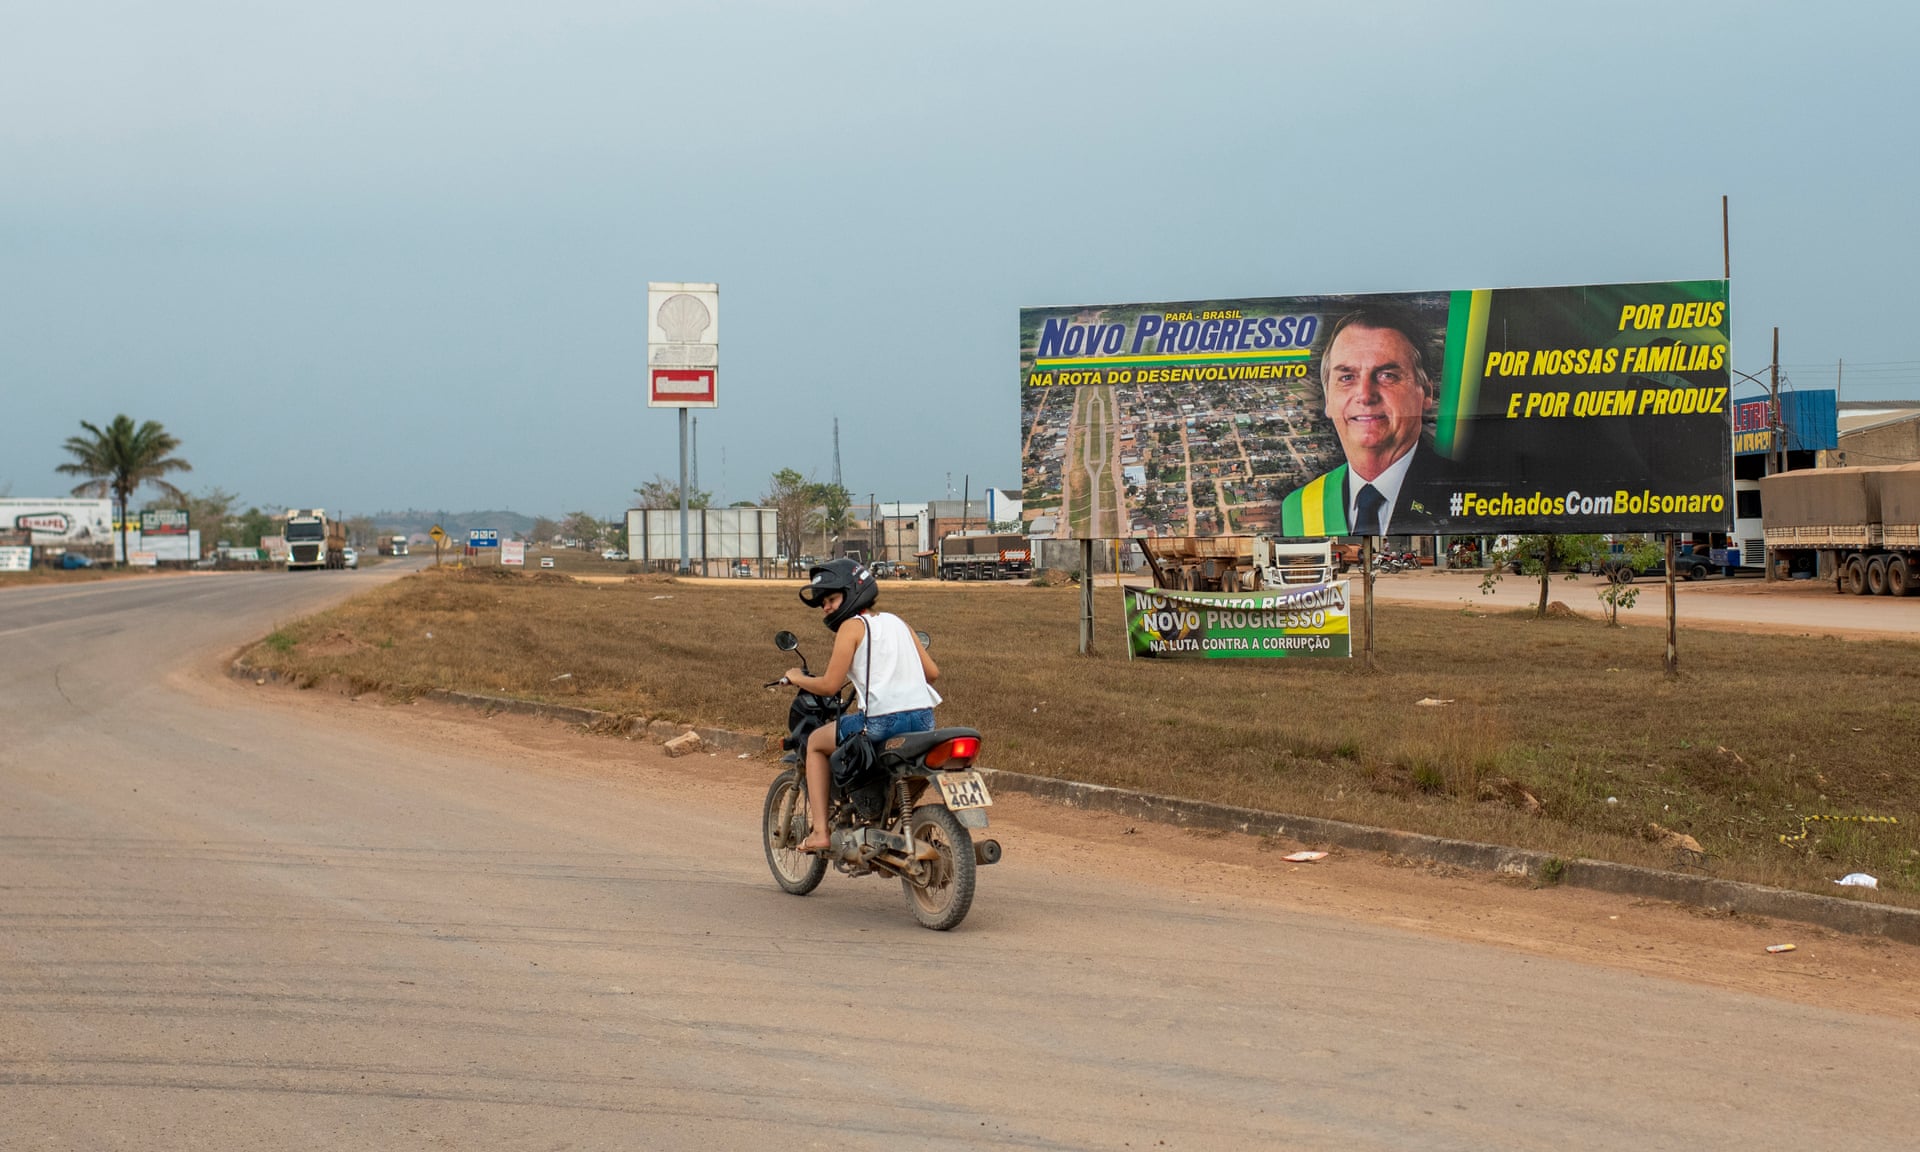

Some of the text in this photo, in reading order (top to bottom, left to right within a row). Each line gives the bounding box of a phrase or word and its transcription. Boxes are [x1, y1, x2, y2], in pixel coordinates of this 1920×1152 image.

[1164, 311, 1192, 321] PARÁ
[1203, 310, 1242, 321] BRASIL
[1618, 301, 1726, 331] POR DEUS
[1037, 314, 1318, 357] NOVO PROGRESSO
[1485, 340, 1726, 377] POR NOSSAS FAMÍLIAS
[1029, 364, 1307, 387] NA ROTA DO DESENVOLVIMENTO
[1507, 387, 1728, 419] E POR QUEM PRODUZ
[1450, 490, 1724, 517] #FechadosComBolsonaro
[1262, 586, 1344, 610] RENOVA
[1144, 609, 1325, 633] NOVO PROGRESSO
[1150, 635, 1330, 652] NA LUTA CONTRA A CORRUPÇÃO
[952, 793, 986, 808] 4041
